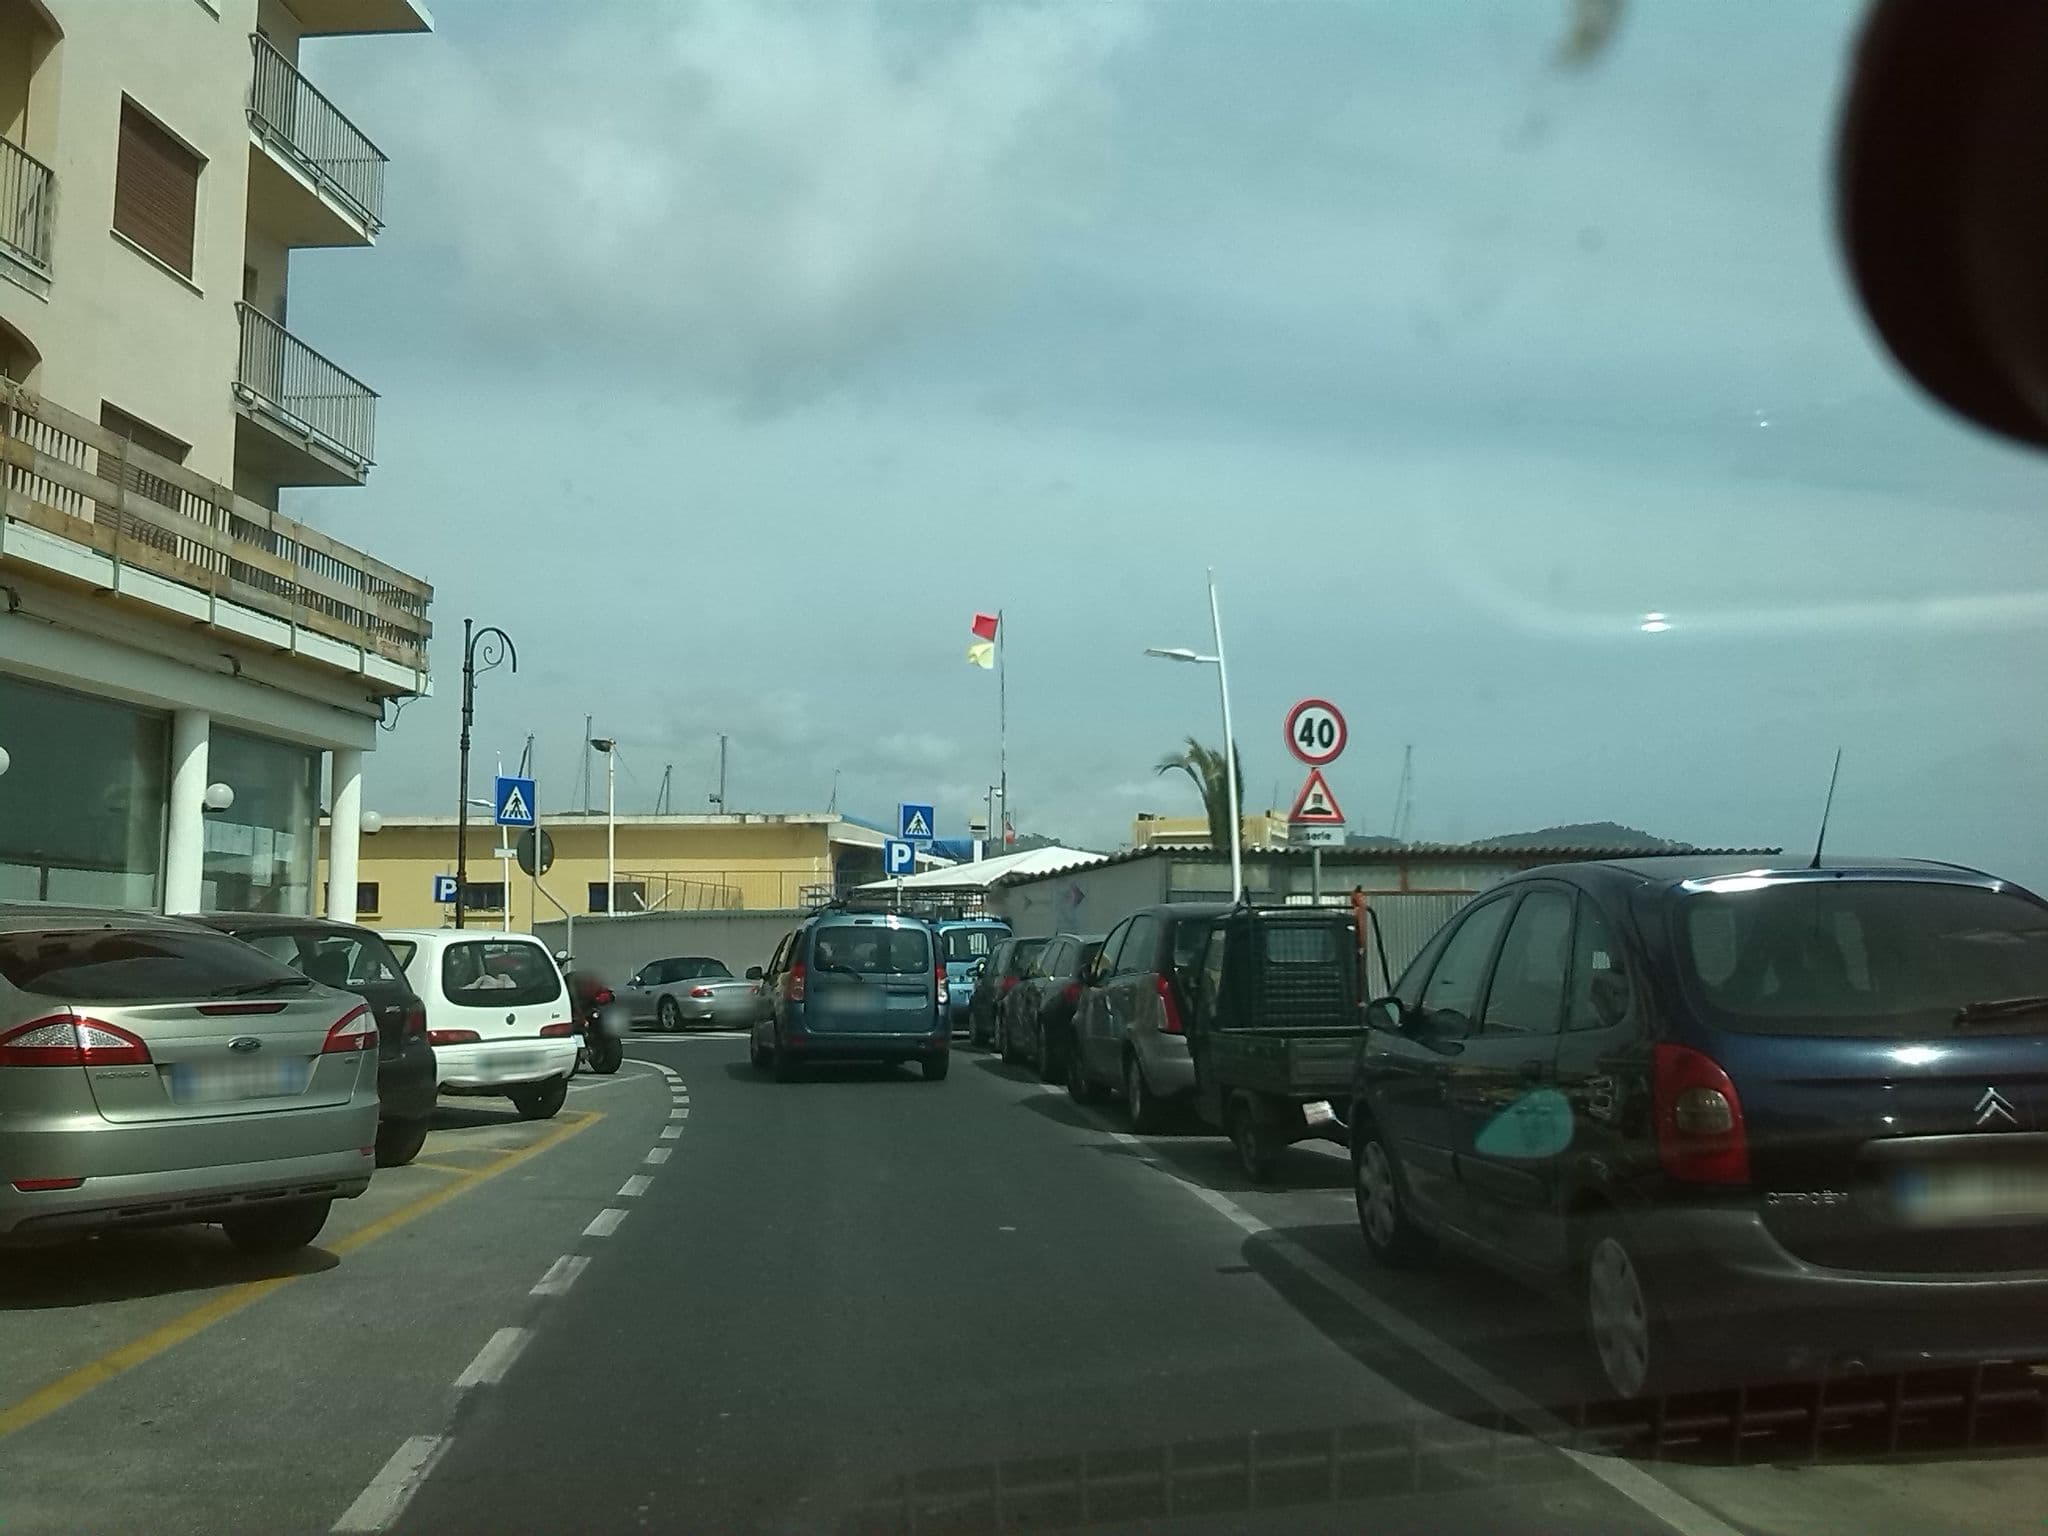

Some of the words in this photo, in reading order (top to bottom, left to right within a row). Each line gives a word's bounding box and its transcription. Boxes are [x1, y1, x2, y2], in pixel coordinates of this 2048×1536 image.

[1299, 718, 1334, 748] 40
[892, 843, 911, 871] P
[440, 879, 457, 900] P
